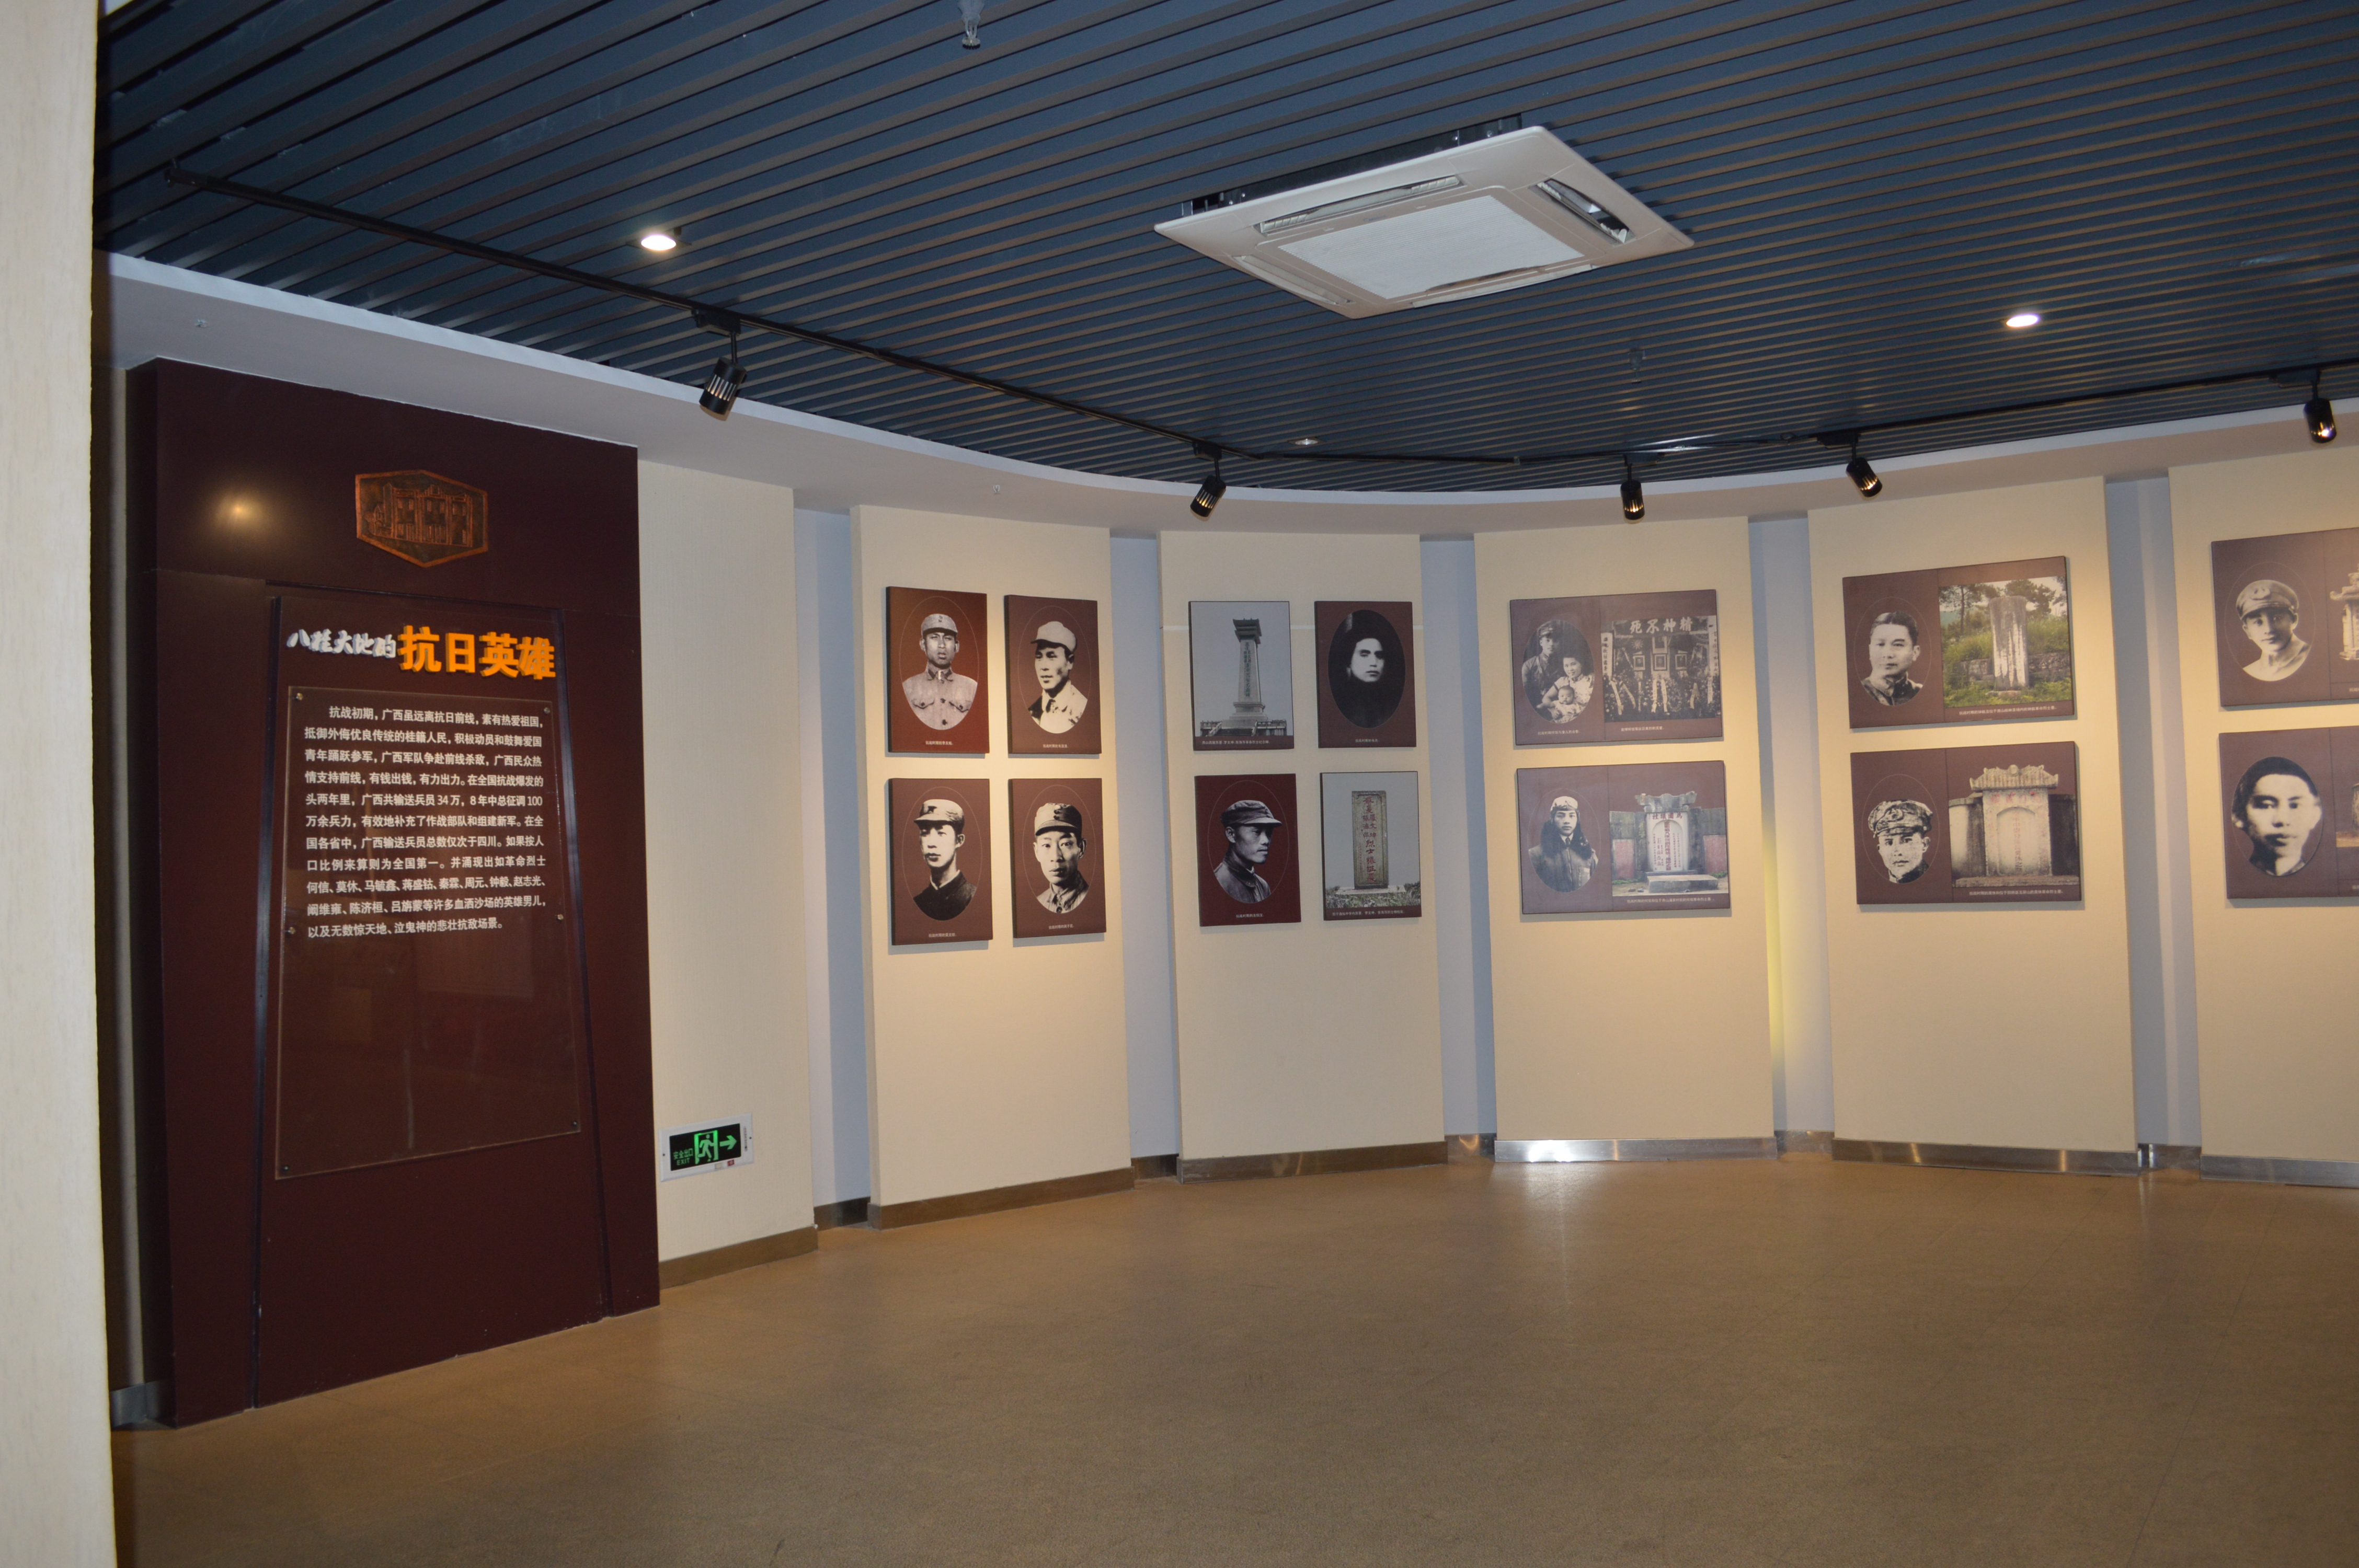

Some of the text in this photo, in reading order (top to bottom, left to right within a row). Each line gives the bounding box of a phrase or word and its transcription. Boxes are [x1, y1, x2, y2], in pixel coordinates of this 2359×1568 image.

[287, 625, 556, 679] 八桂大地的 抗日英雄
[329, 706, 543, 728] 抗战初期，广西虽远离抗日前线，素有热爱祖国，
[304, 727, 542, 747] 抵御外侮优良传统的桂籍人民，积极动员和鼓舞爱国
[304, 748, 542, 767] 青年踊跃参军，广西军队争赴前线杀敌，广西民众热
[304, 770, 544, 787] 情支持前线，有钱出钱，有力出力。在全国抗战爆发的
[306, 815, 544, 828] 万余兵力，有效地补充了作战部队和组建新军。在全
[306, 835, 544, 850] 国各省中，广西输送兵员总数仅次于四川。如果按人
[307, 855, 546, 871] 口比例来算则为全国第一。并涌现出如革命烈士
[308, 917, 503, 938] 以及无数惊天地、泣鬼神的悲壮抗敌场景。
[673, 1148, 694, 1160] 安全出口
[677, 1157, 690, 1166] EXIT
